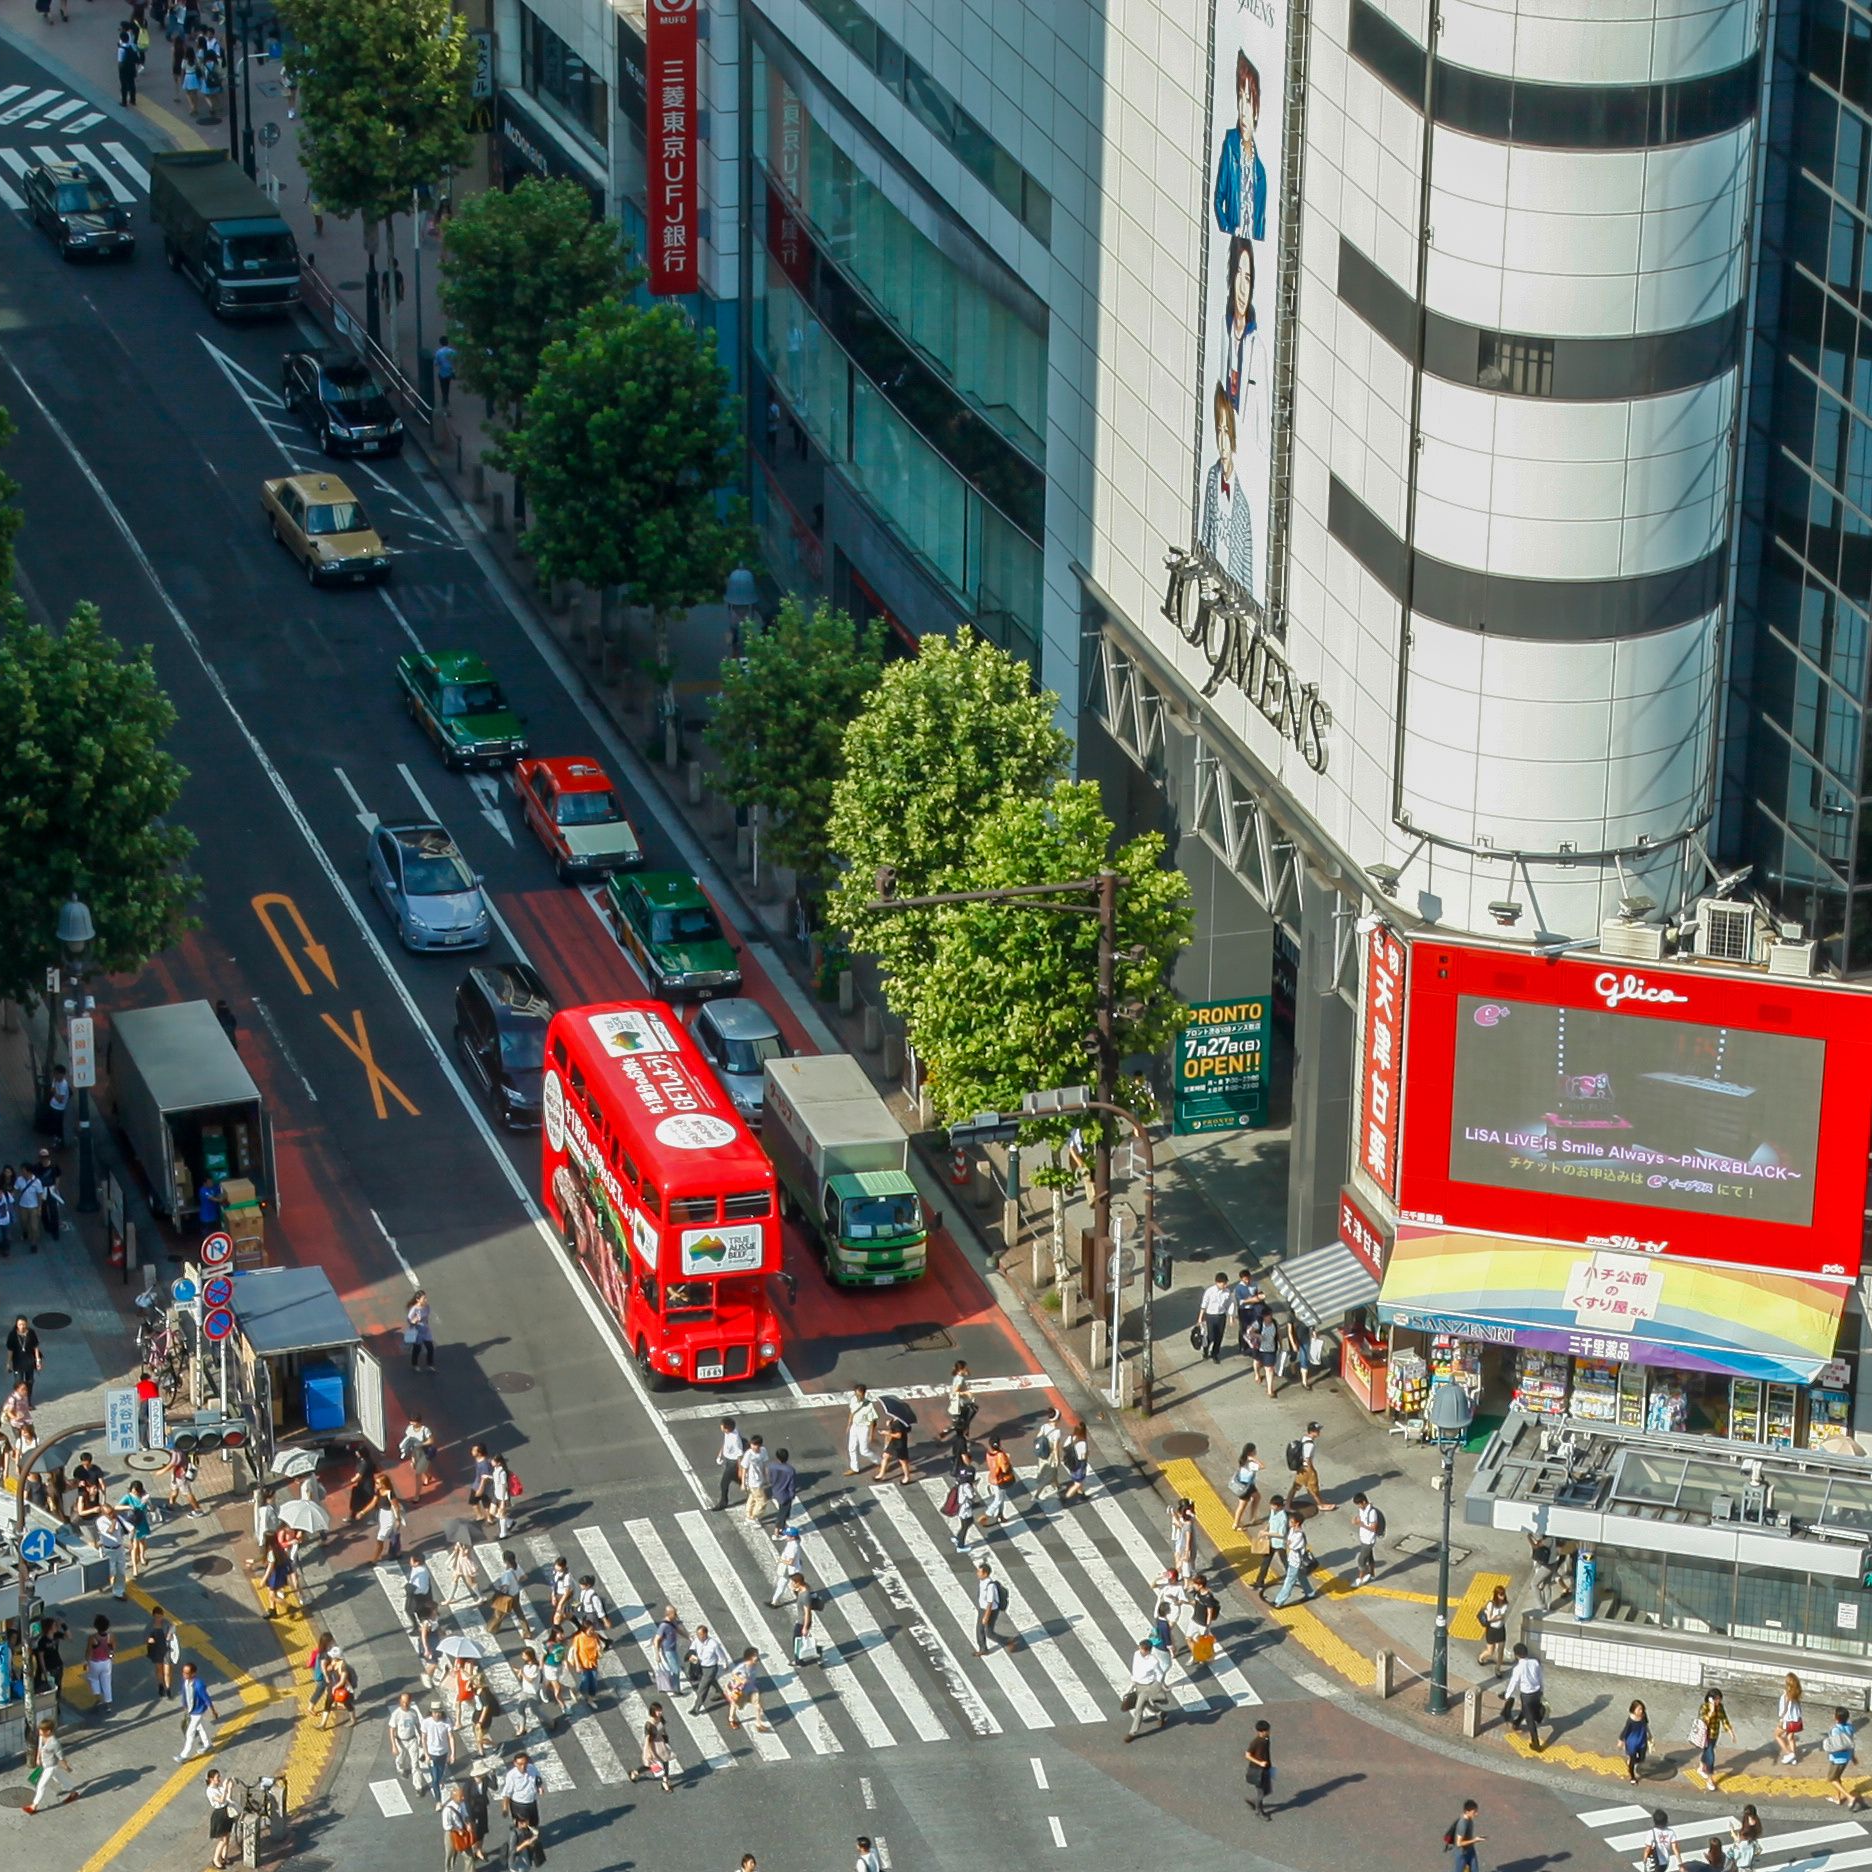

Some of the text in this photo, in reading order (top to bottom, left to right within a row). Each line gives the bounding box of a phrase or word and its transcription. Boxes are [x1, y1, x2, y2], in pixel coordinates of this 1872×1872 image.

[660, 16, 687, 24] MUFG
[662, 60, 687, 272] 三菱東京UFJ銀行
[1594, 972, 1689, 1008] Glico
[1188, 1003, 1263, 1025] PRONTO
[1184, 1053, 1261, 1078] OPEN!!
[1366, 965, 1394, 1182] 天津甘栗
[1465, 1127, 1500, 1143] LiSA
[1505, 1133, 1541, 1148] LiVE
[1561, 1140, 1604, 1157] Smile
[1608, 1145, 1664, 1165] Always
[1508, 1157, 1644, 1184] チケットのお申込みは
[1342, 1204, 1382, 1270] 天津甘栗
[1584, 1265, 1649, 1286] ハチ公前
[1605, 1284, 1619, 1297] の
[1411, 1315, 1516, 1344] SANZENRI
[1568, 1335, 1630, 1361] 三千里薬品
[119, 1393, 134, 1449] 渋谷駅前
